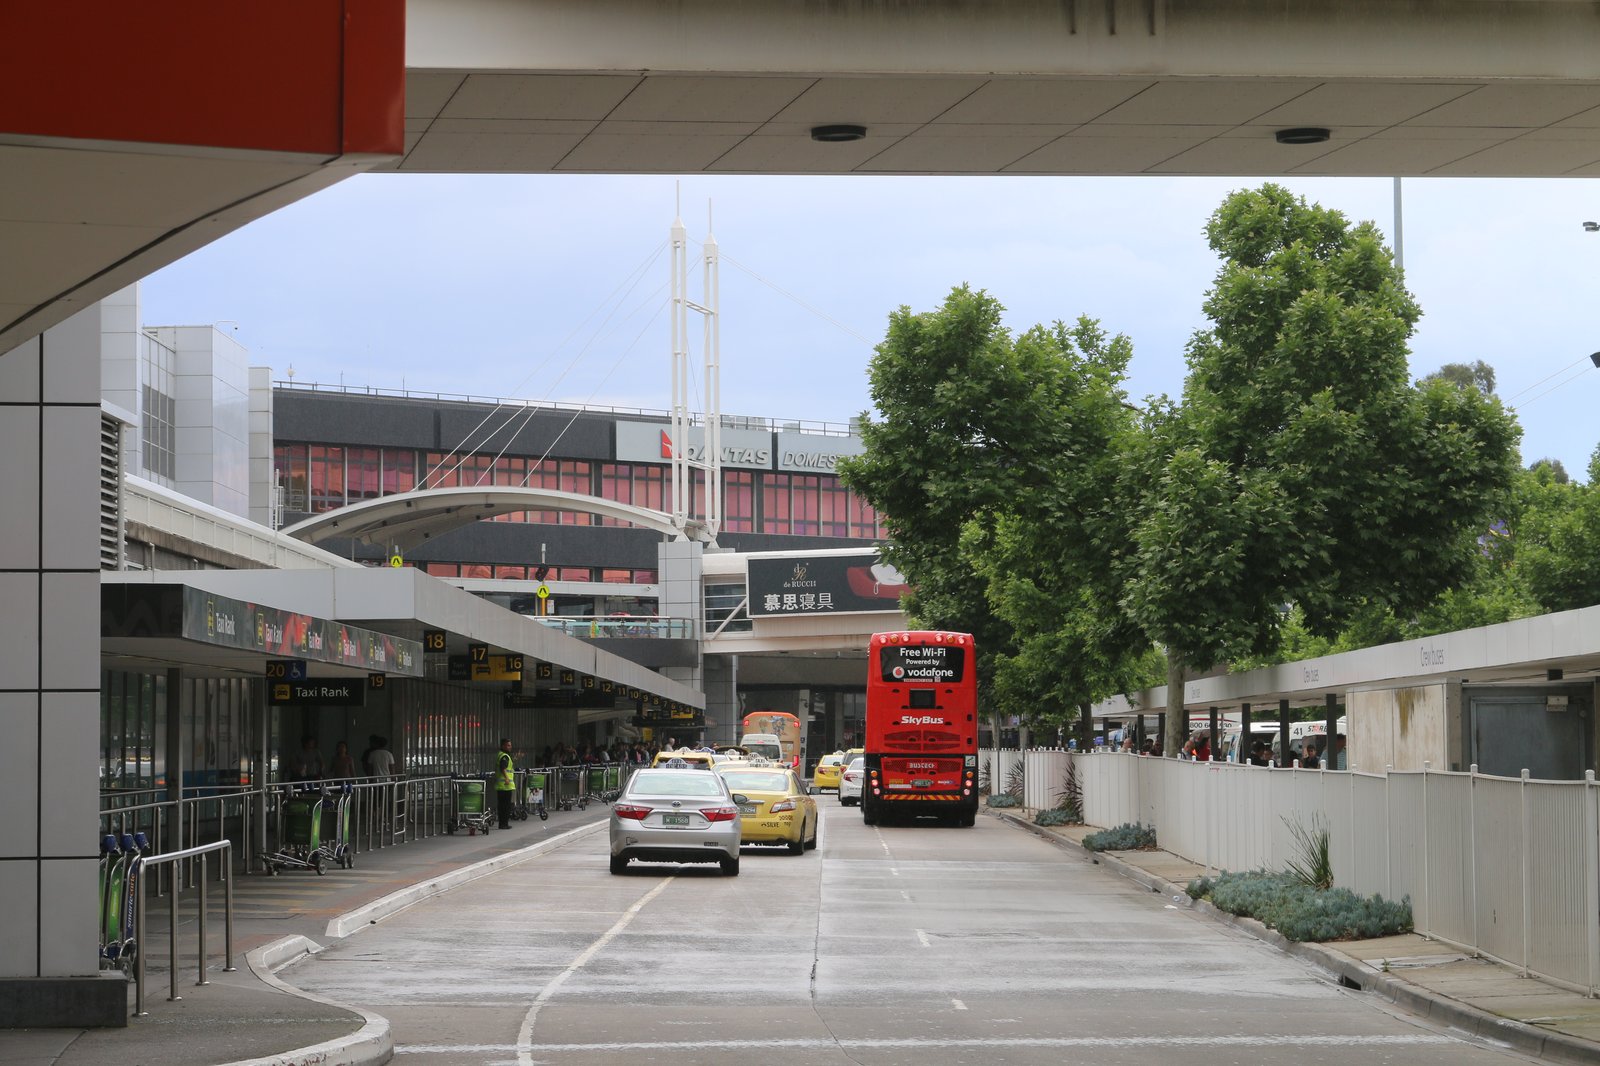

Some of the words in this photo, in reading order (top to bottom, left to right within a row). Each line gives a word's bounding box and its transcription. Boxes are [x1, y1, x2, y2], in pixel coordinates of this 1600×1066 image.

[763, 592, 834, 612] 慕思寝具
[216, 612, 225, 633] Taxi
[225, 614, 236, 636] Rank
[426, 634, 444, 649] 18
[471, 647, 486, 661] 17
[900, 648, 921, 657] Free
[922, 648, 946, 657] Wi-Fi
[509, 657, 522, 670] 16
[267, 664, 285, 677] 20
[540, 666, 551, 677] 15
[907, 668, 954, 677] vodafone
[371, 676, 384, 687] 19
[563, 673, 573, 684] 14
[584, 678, 593, 688] 13
[296, 687, 318, 697] Taxi
[321, 687, 349, 697] Rank
[602, 683, 612, 693] 12
[618, 687, 626, 696] 11
[630, 690, 639, 699] 10
[901, 715, 944, 725] SkyBus
[1294, 727, 1303, 736] 41
